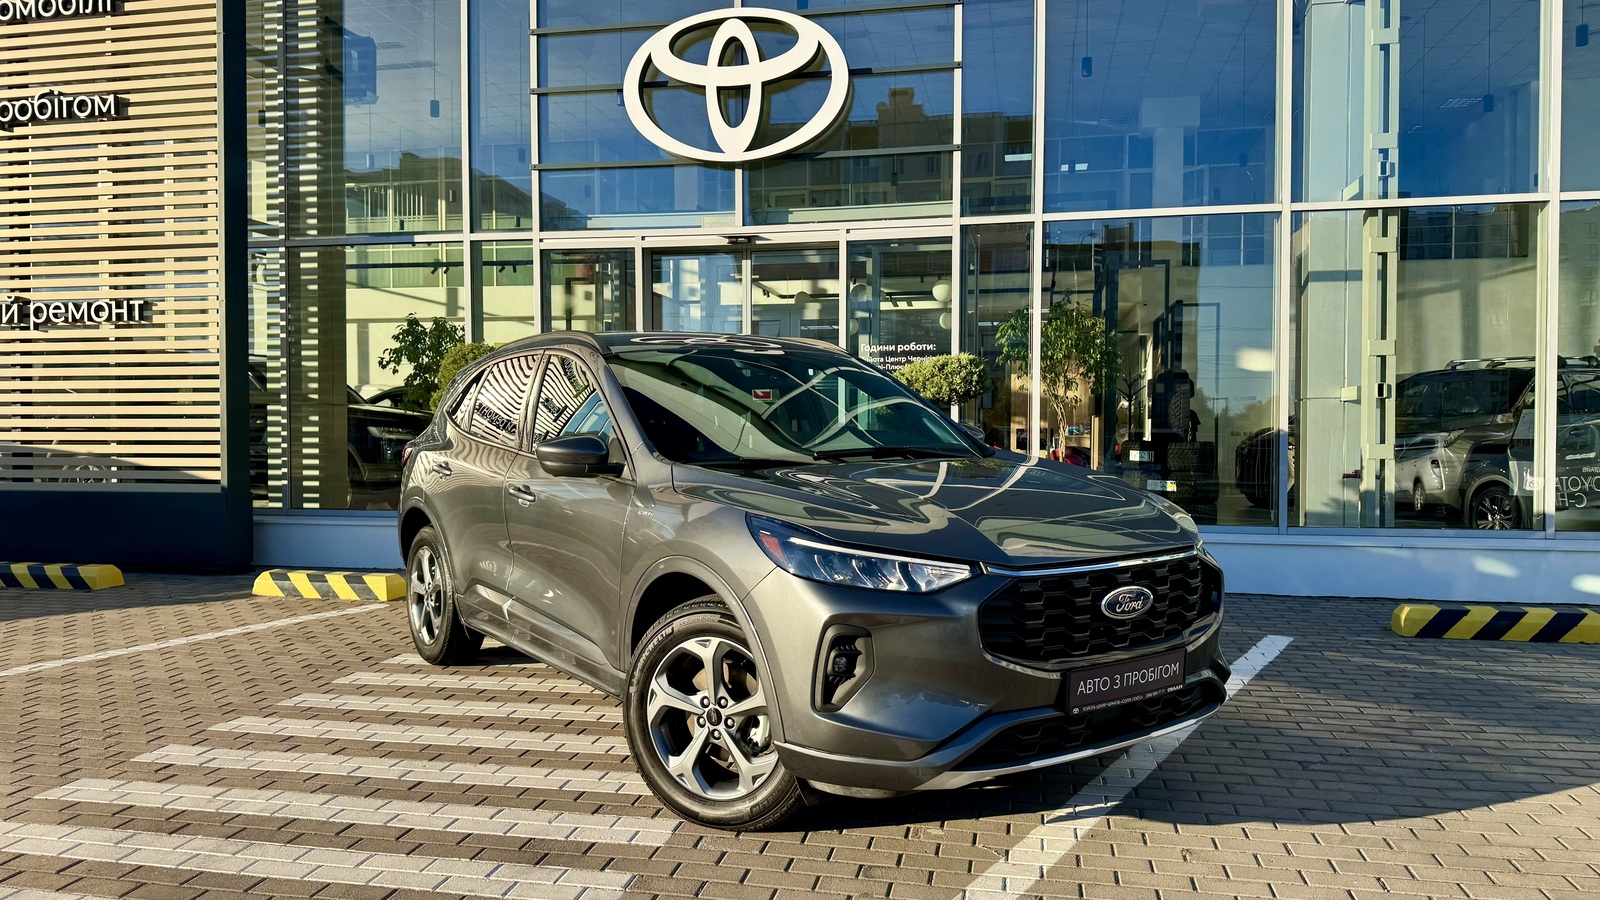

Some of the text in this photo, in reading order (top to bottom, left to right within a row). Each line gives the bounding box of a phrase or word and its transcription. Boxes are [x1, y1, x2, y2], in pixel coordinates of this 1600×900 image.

[30, 299, 144, 331] ремонт
[860, 341, 937, 353] Години роботи:
[885, 355, 907, 363] Центр
[1115, 594, 1144, 612] Ford
[1077, 676, 1110, 695] АВТО
[1123, 662, 1179, 687] ПРОБІГОМ
